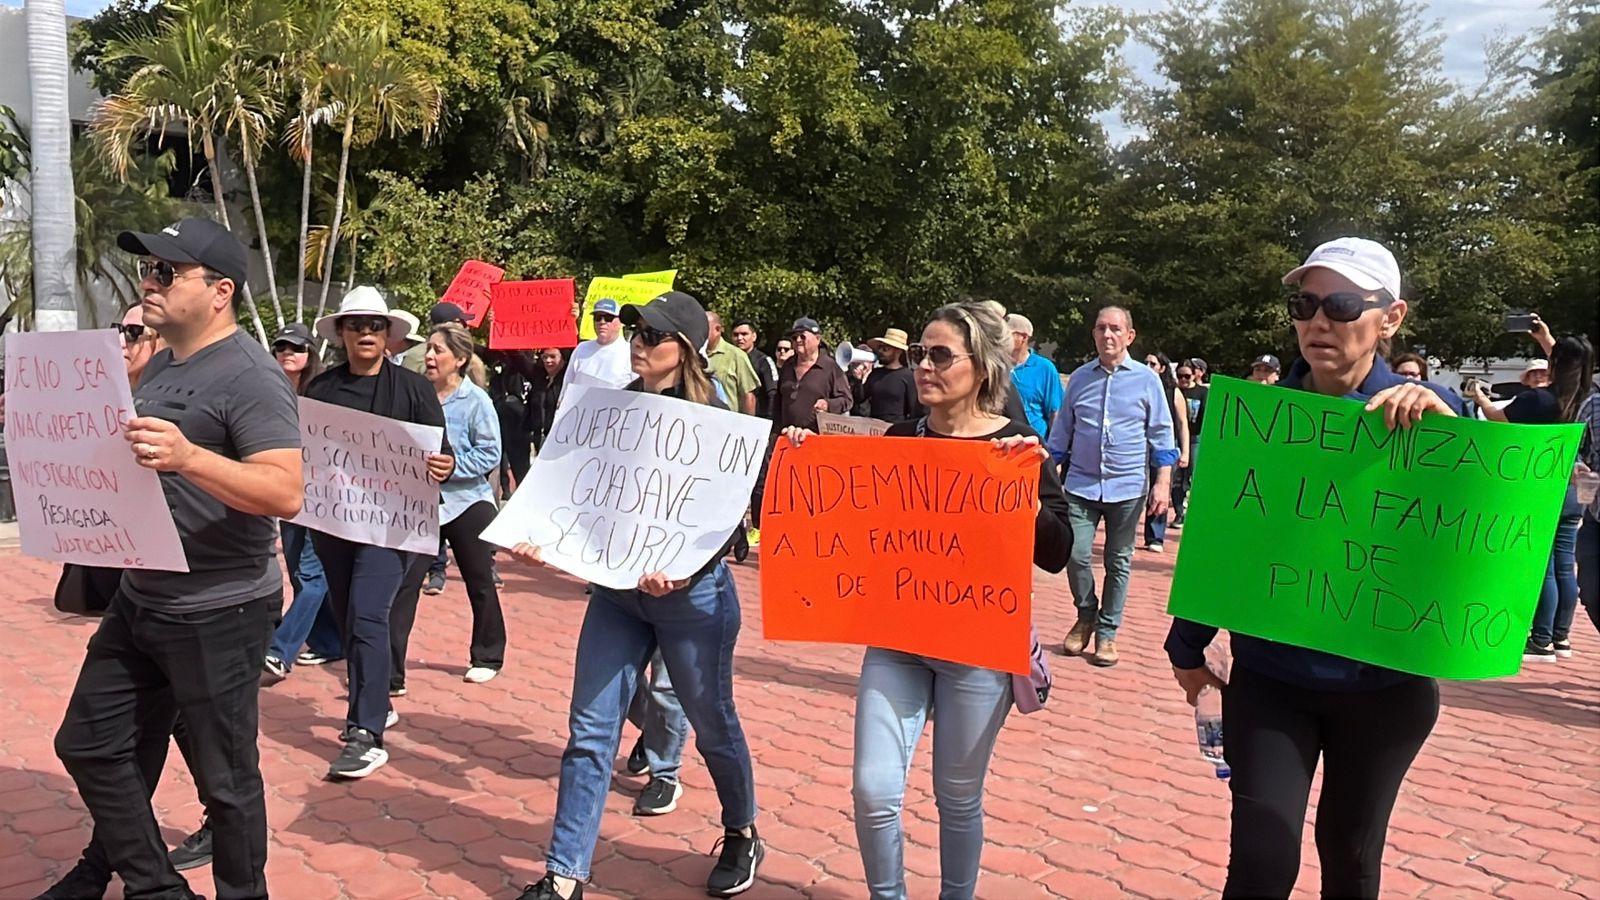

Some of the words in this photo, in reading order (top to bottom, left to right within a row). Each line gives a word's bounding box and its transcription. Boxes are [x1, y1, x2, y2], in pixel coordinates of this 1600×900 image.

[34, 356, 60, 391] NO
[73, 357, 108, 391] SEA
[342, 430, 363, 445] SU
[554, 405, 702, 466] QUEREMOS
[718, 432, 759, 476] UN
[1218, 391, 1568, 482] INDEMNIZACIÓN
[571, 456, 711, 528] GUASAVE
[768, 447, 1034, 517] INDEMNIZACION
[1233, 468, 1266, 517] A
[1295, 476, 1348, 525] LA
[1371, 489, 1532, 554] FAMILIA
[528, 506, 686, 573] SEGURO
[773, 533, 796, 556] A
[815, 531, 849, 558] LA
[869, 528, 965, 558] FAMILIA
[1343, 540, 1400, 587] DE
[836, 572, 867, 598] DE
[895, 567, 1017, 614] PINDARO
[1268, 562, 1512, 652] PINDARO
